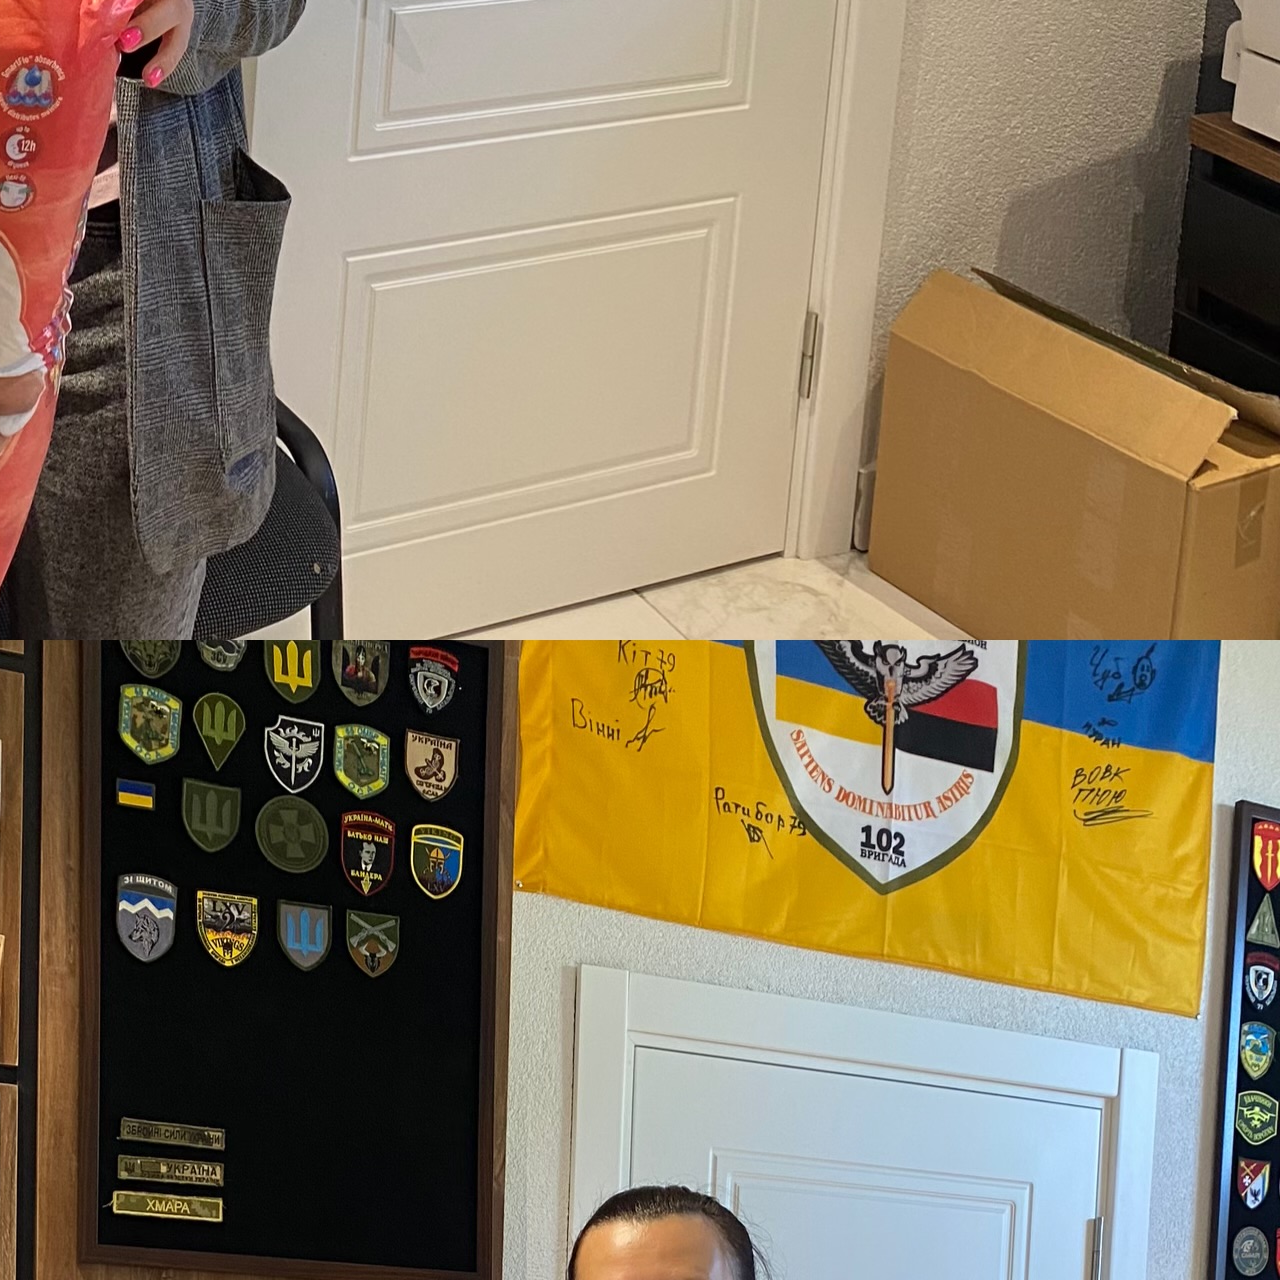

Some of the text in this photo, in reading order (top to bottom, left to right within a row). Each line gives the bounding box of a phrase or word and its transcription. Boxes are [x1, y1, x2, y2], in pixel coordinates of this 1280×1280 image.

[21, 140, 36, 153] 12h
[411, 734, 453, 751] УКРАЇНА
[790, 728, 976, 822] SAPIENS DOMINABITUR ASTRIS
[1072, 764, 1130, 789] ВОВК
[347, 830, 389, 844] БАТЬКО НАШ
[860, 824, 906, 857] 102
[860, 848, 907, 868] БРИГАДА
[136, 876, 173, 893] ЩИТОМ
[211, 900, 246, 915] LXV
[166, 1164, 217, 1178] УКРАЇНА
[146, 1199, 191, 1214] ХМАРА
